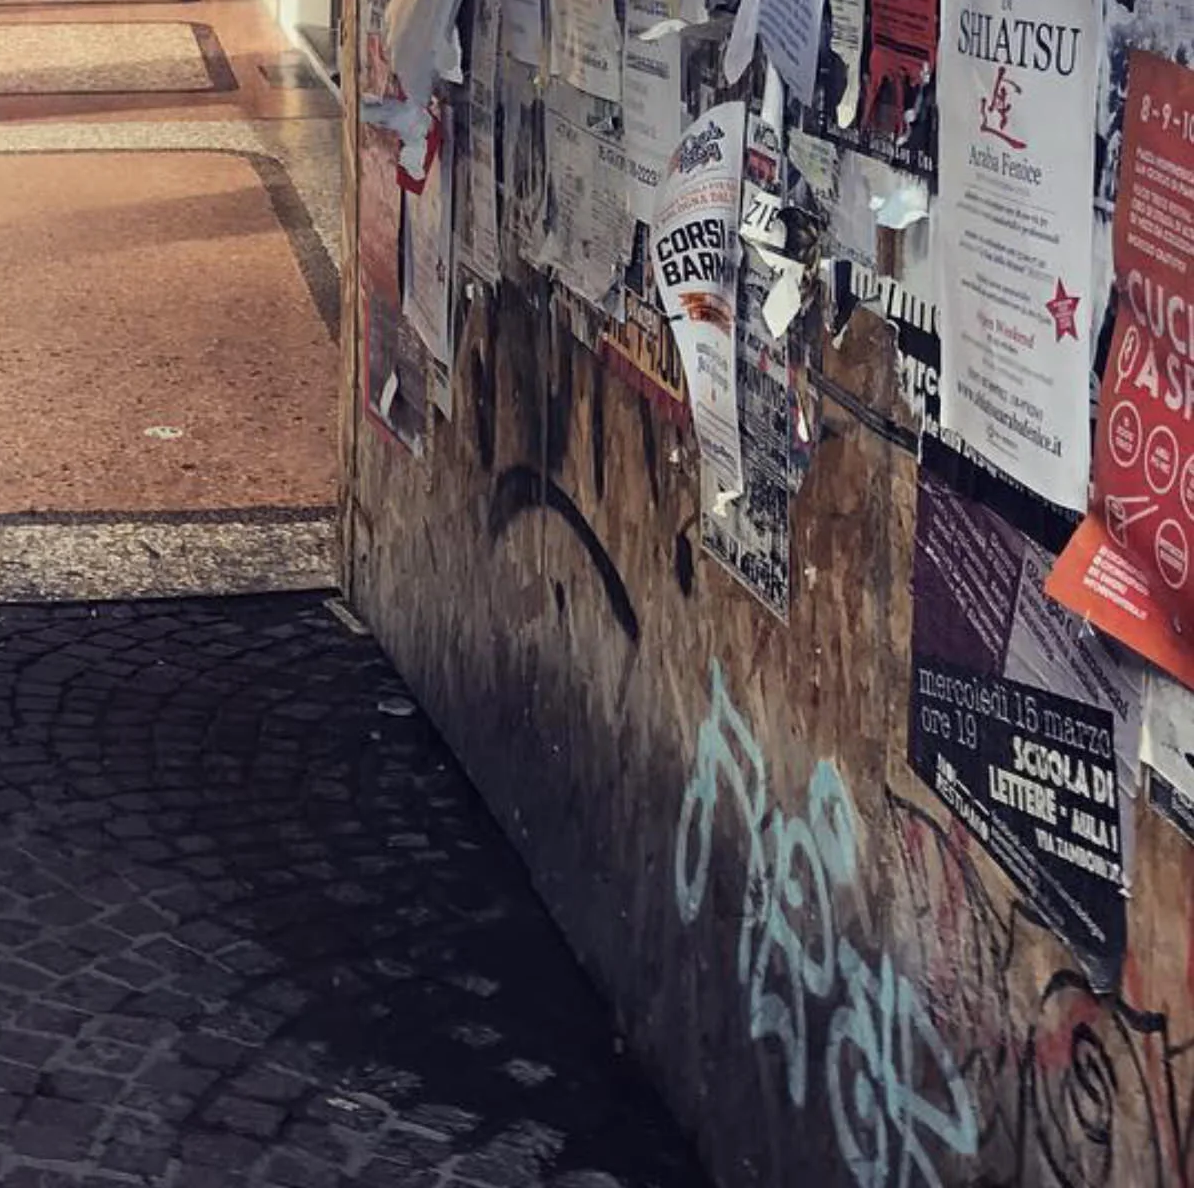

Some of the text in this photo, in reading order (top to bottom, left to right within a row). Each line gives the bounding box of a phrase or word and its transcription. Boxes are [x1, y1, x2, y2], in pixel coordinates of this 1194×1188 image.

[957, 9, 1082, 77] SHIATSU
[1002, 152, 1043, 186] Fenice
[921, 705, 979, 751] ore 19
[1044, 707, 1112, 760] marzo
[988, 764, 1058, 826] LETTERE
[1012, 734, 1117, 809] SCUOLA DI
